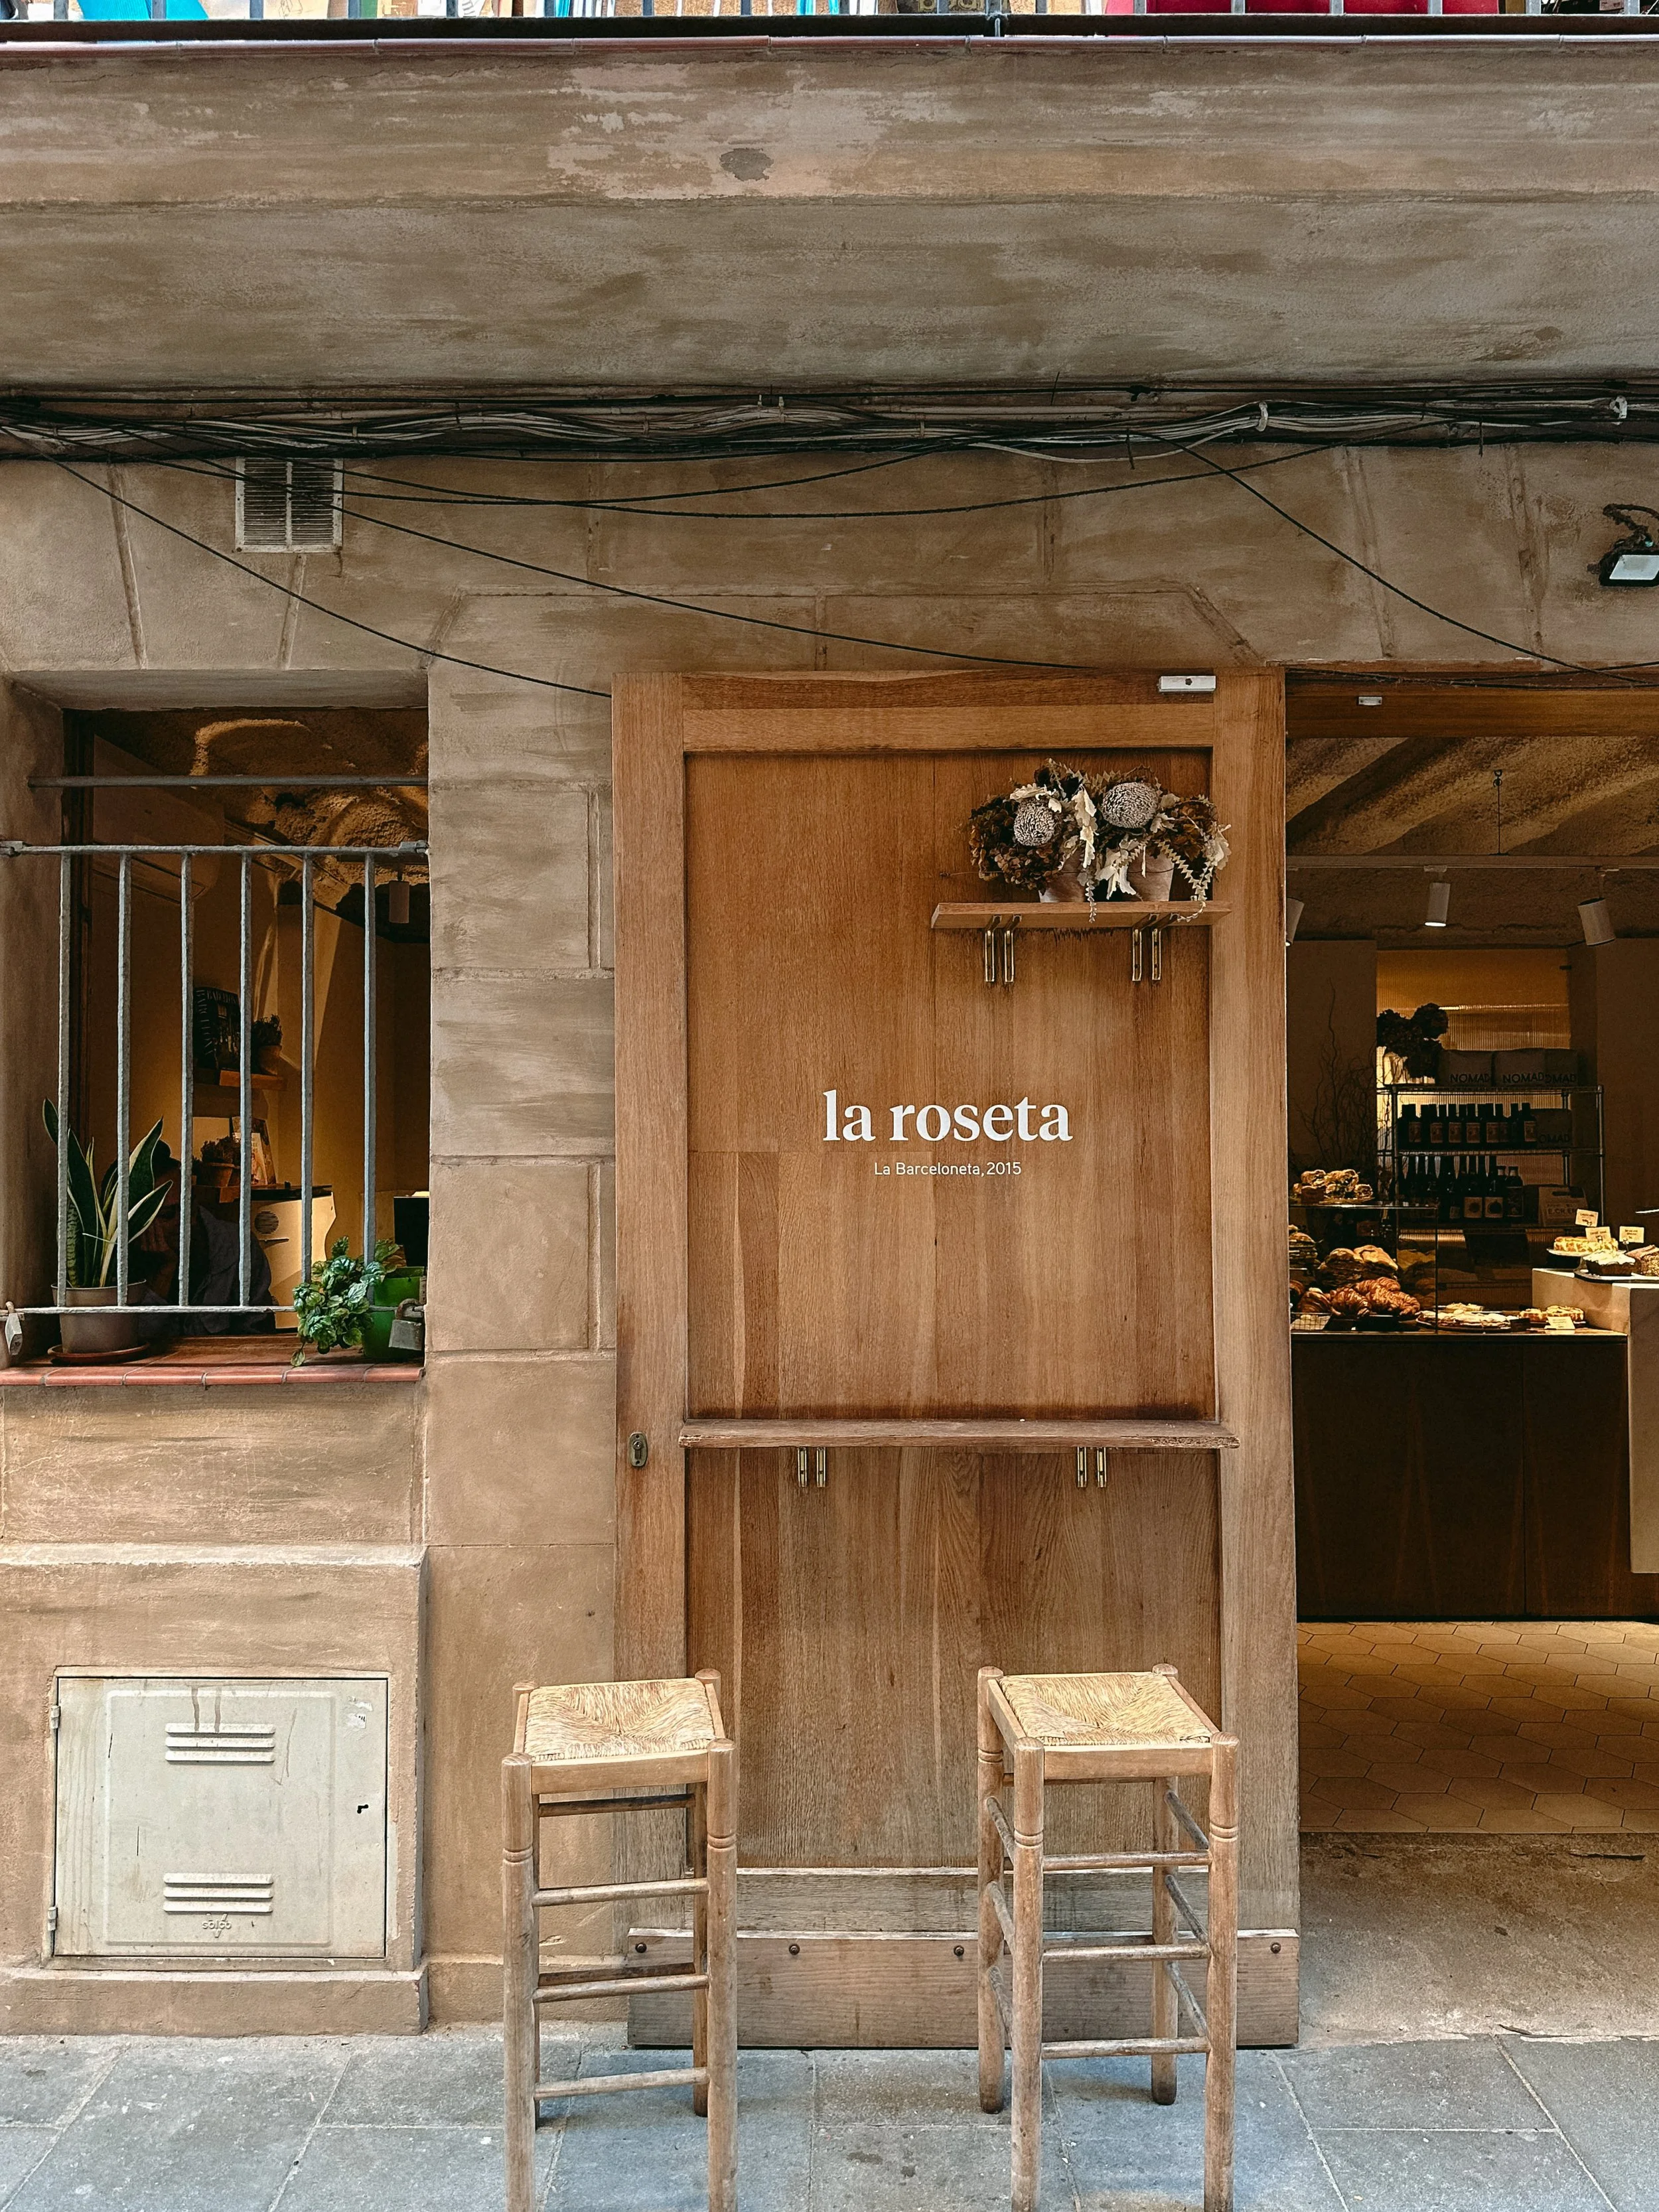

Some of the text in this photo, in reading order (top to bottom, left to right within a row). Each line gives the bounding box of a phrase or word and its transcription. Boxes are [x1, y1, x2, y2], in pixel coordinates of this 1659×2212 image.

[1450, 1073, 1490, 1084] NOMAD
[1502, 1072, 1544, 1084] NOMAD
[1544, 1073, 1577, 1084] OMAD
[823, 1089, 1073, 1142] la roseta
[1539, 1133, 1570, 1143] OMAD
[874, 1162, 891, 1175] La
[986, 1161, 1022, 1175] 2015
